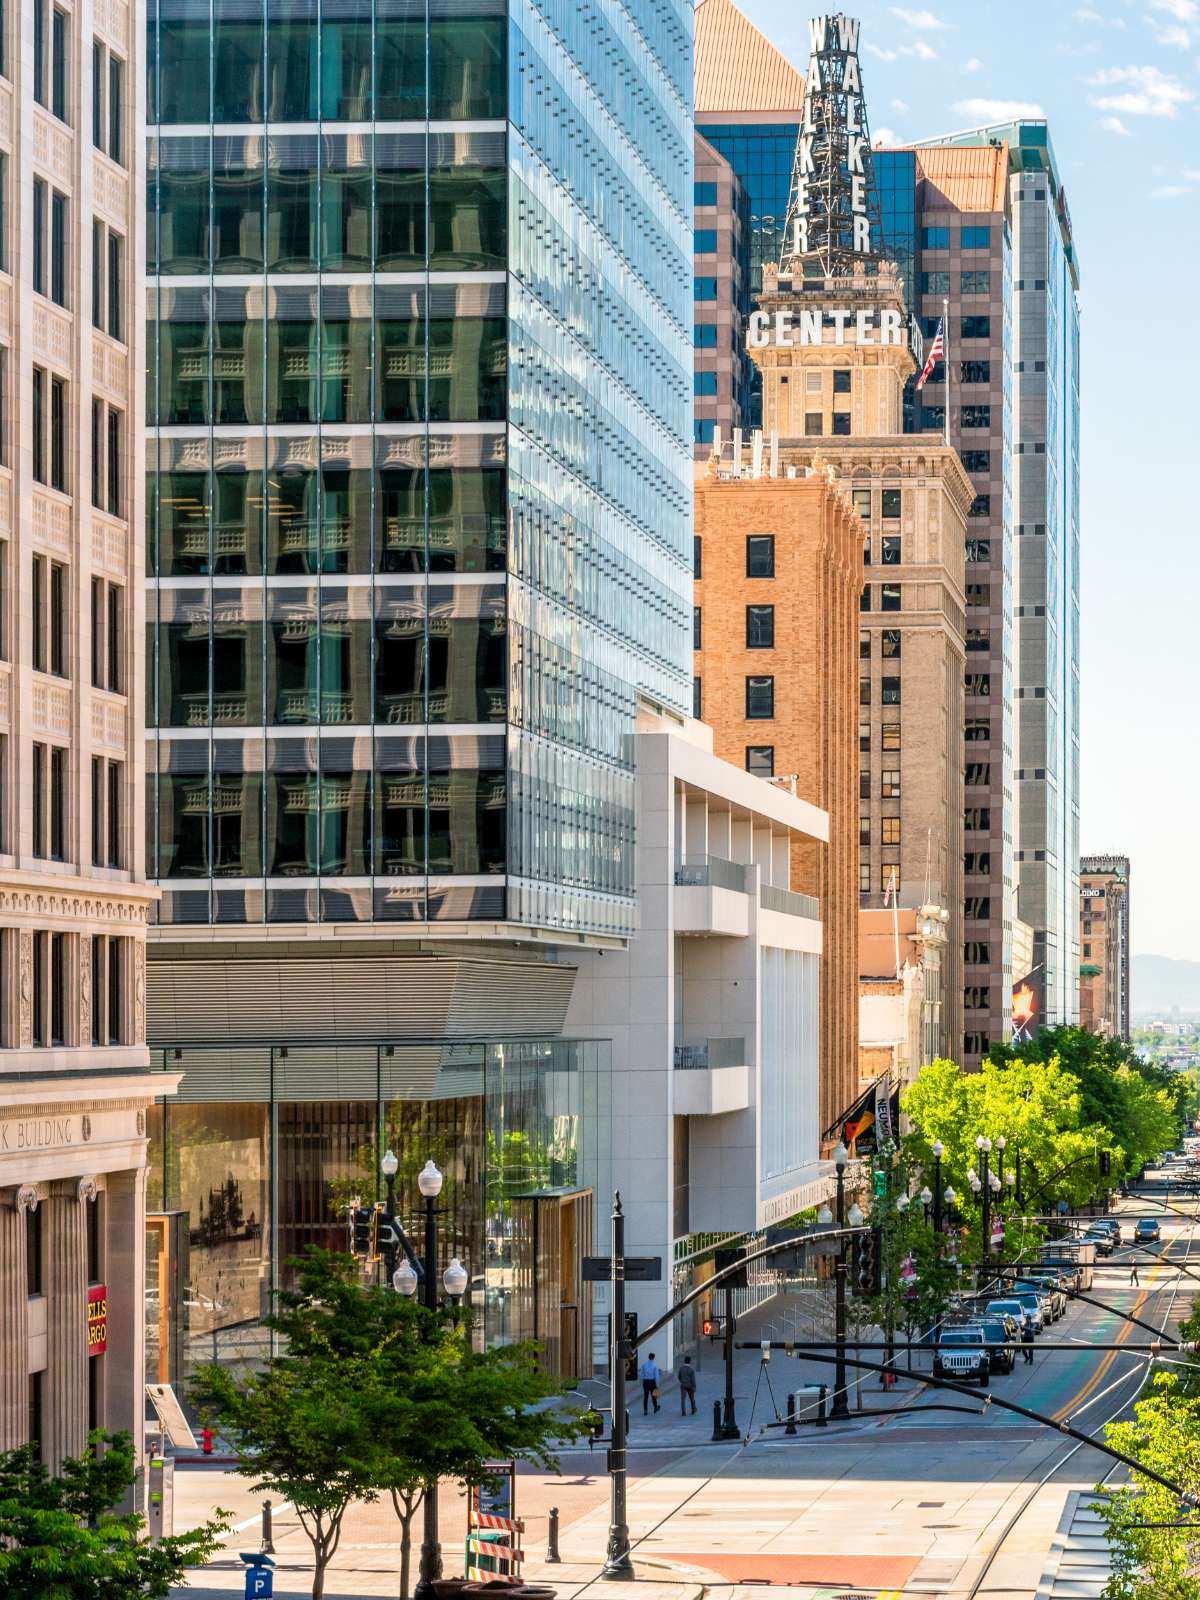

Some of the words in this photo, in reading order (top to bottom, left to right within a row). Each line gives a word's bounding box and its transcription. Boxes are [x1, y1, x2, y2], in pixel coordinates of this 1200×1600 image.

[794, 16, 827, 255] WALKER
[838, 16, 870, 253] WALKER
[749, 310, 902, 347] CENTER
[17, 1118, 72, 1149] BUILDING
[88, 1300, 107, 1322] ELLS
[254, 1579, 265, 1593] P
